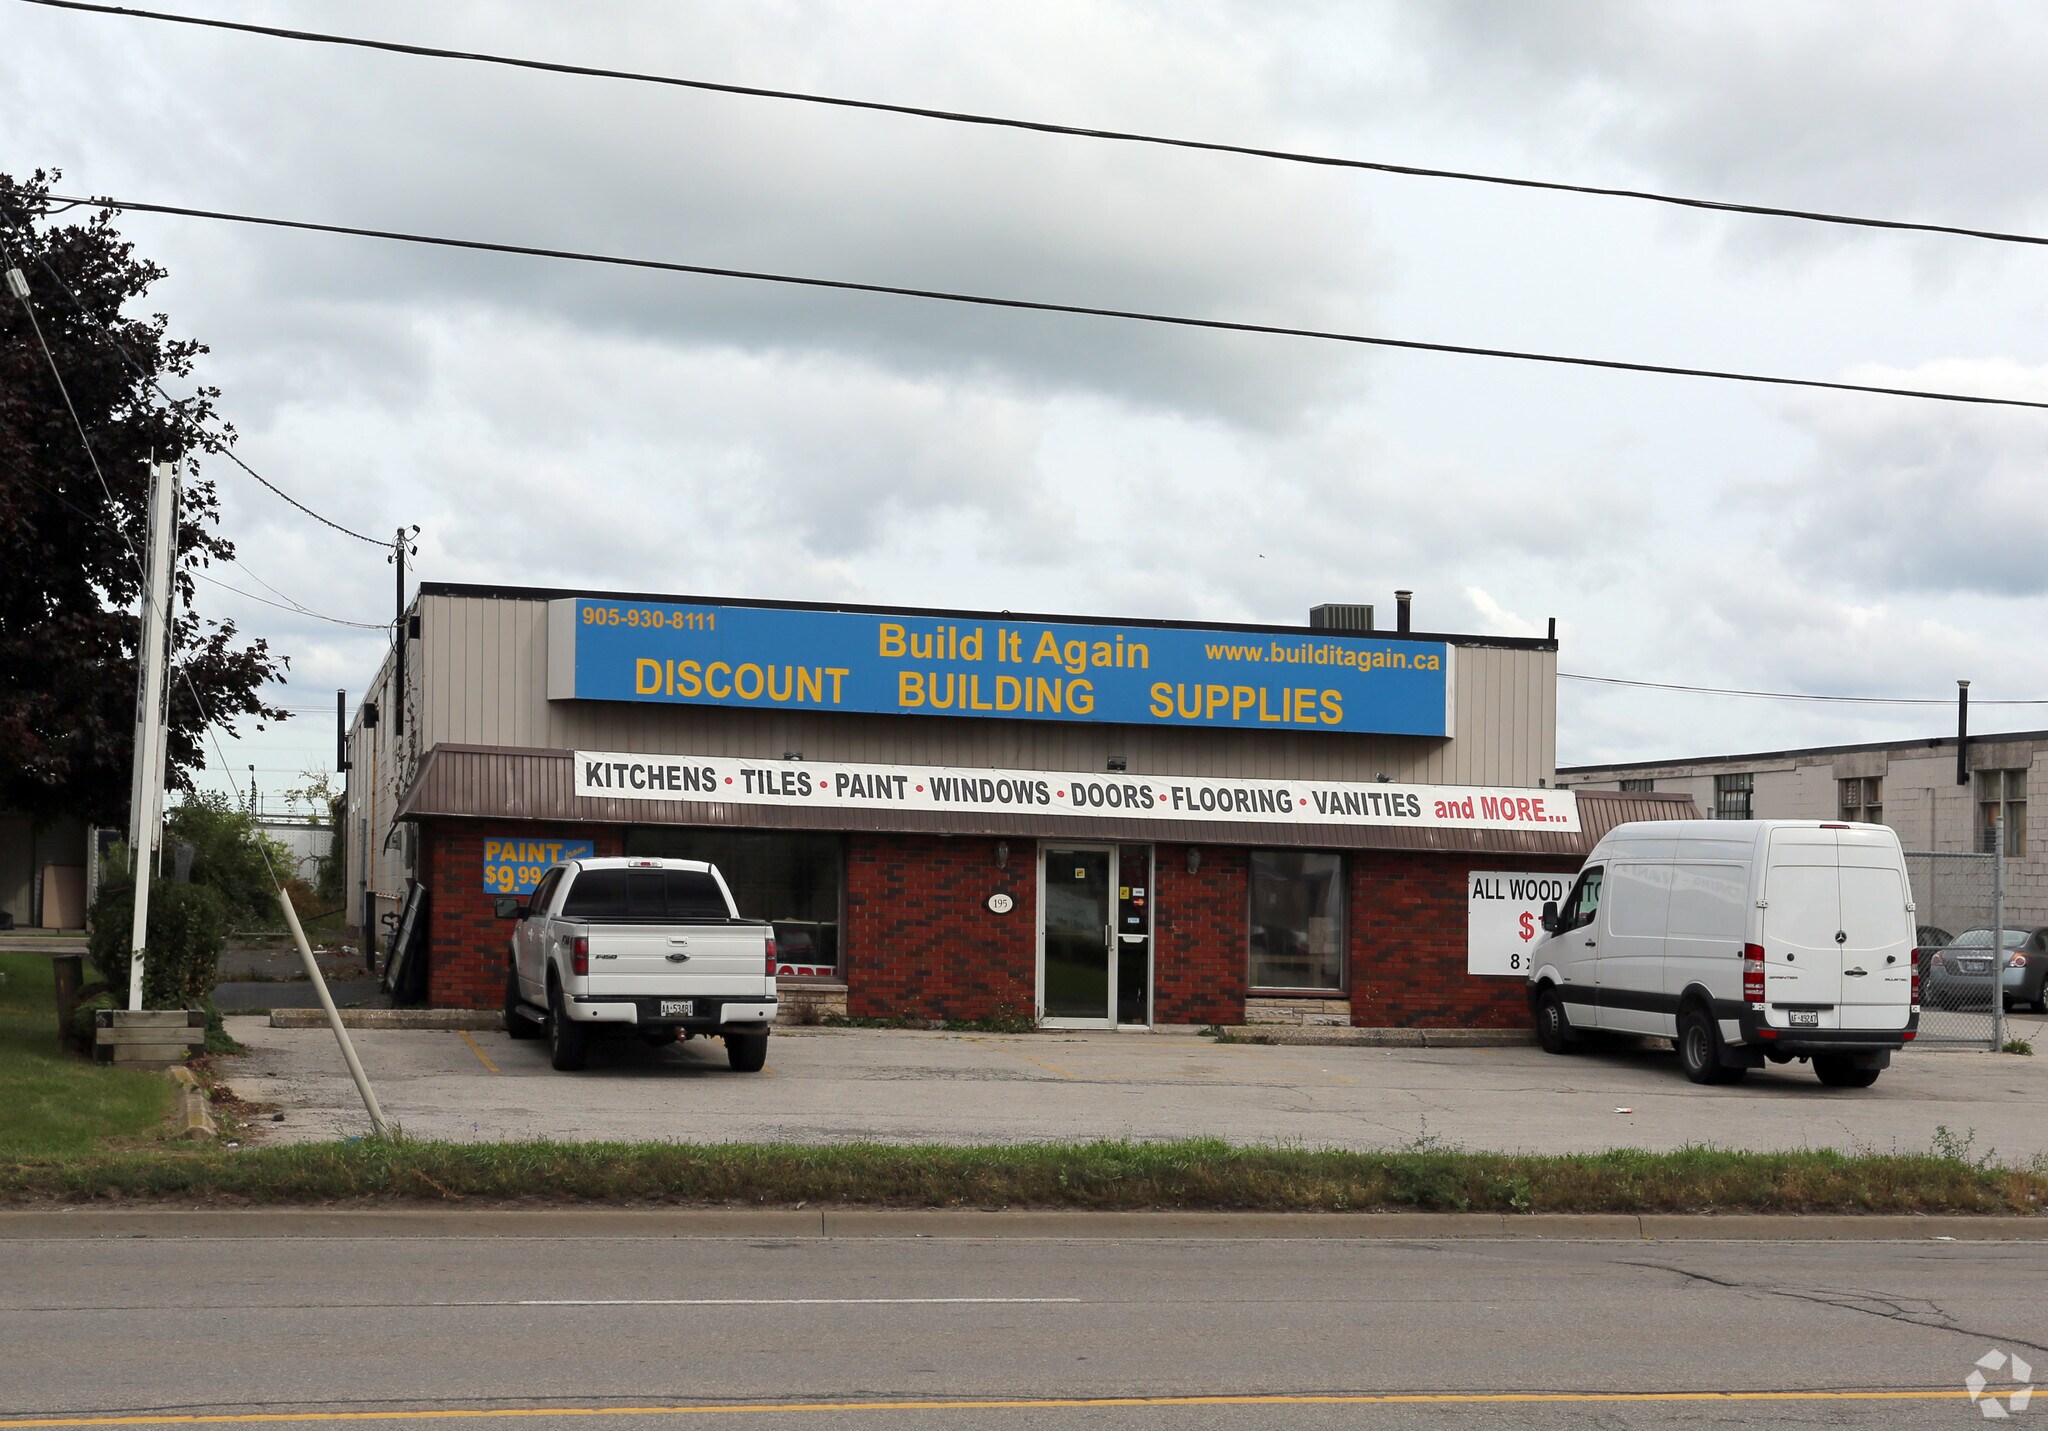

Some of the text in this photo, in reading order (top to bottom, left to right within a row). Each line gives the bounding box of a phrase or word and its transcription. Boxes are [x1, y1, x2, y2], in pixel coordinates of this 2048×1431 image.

[583, 607, 716, 630] 905-930-8111
[879, 624, 1149, 675] Build It Again
[1205, 642, 1440, 672] www.builditagain.ca
[636, 658, 1343, 725] DISCOUNT BUILDING SUPPLIES
[586, 761, 717, 793] KITCHENS
[740, 768, 812, 797] TILES
[835, 773, 908, 800] PAINT
[929, 777, 1051, 805] WINDOWS
[1070, 782, 1155, 809] DOORS
[1171, 786, 1293, 814] FLOORING
[1311, 790, 1421, 818] VANITIES
[1434, 796, 1475, 819] and
[485, 841, 563, 863] PAINT
[1472, 878, 1505, 900] ALL
[1509, 879, 1563, 901] WOOD
[993, 899, 1008, 909] 195
[1510, 953, 1520, 970] 8
